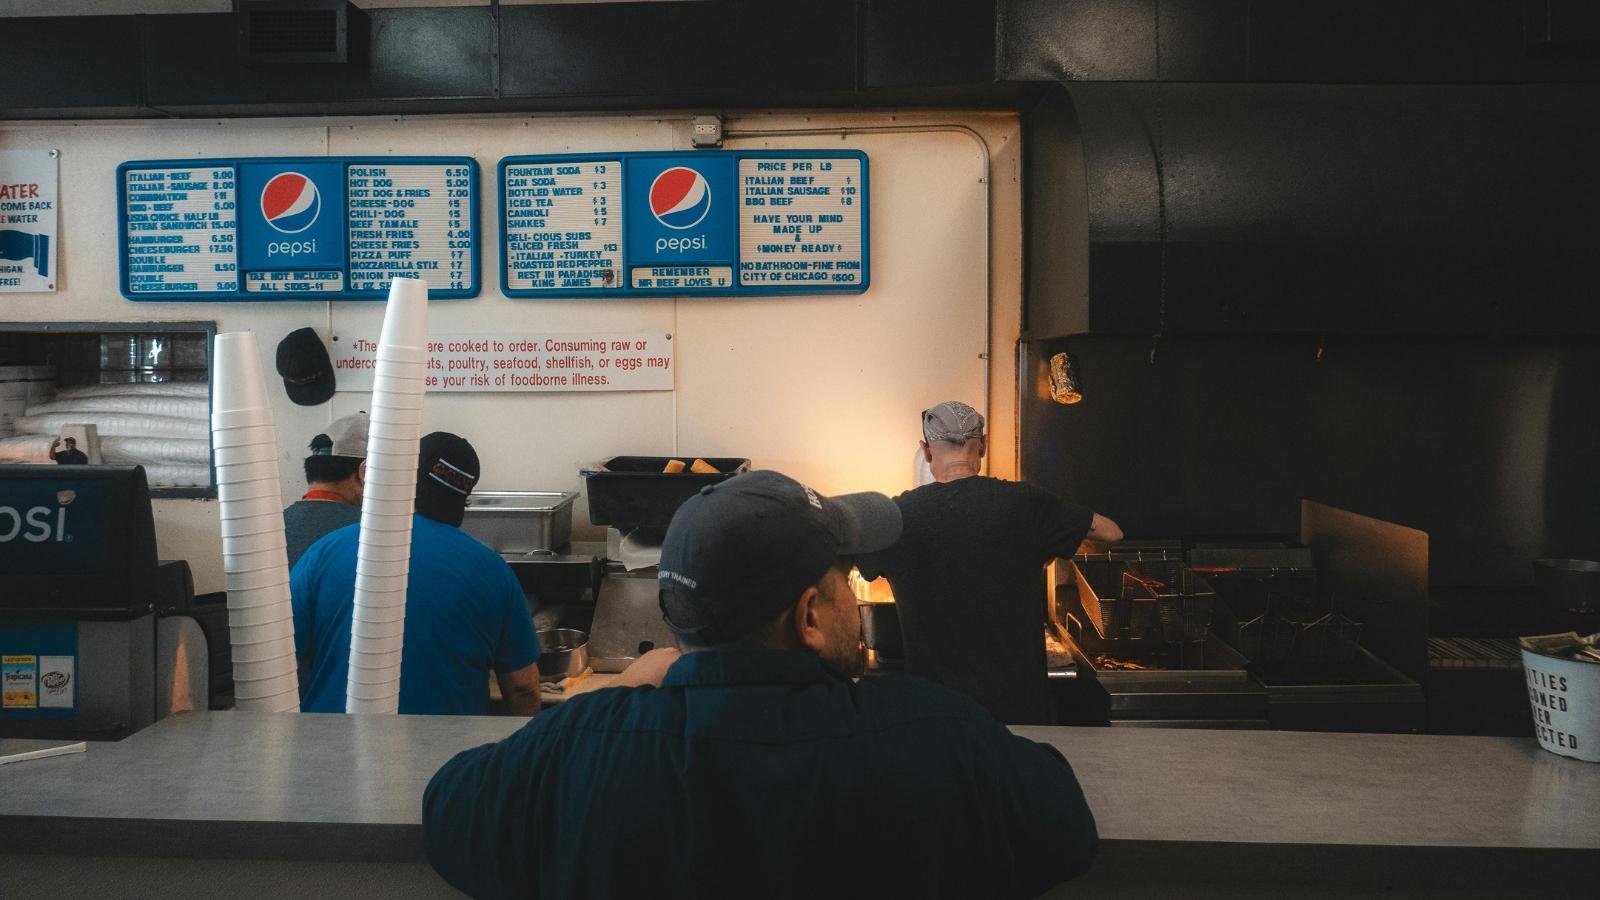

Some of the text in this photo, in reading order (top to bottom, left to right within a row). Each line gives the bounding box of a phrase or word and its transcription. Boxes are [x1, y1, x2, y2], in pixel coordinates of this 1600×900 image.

[758, 163, 832, 171] PRICE PER LB
[508, 168, 553, 176] FOUNTAIN
[350, 179, 368, 187] HOT
[373, 179, 393, 187] DOG
[745, 177, 815, 185] ITALIAN BEEF
[350, 189, 468, 197] HOT DOG & FRIES 7.00
[508, 189, 549, 197] BOTTLED
[745, 187, 783, 195] ITALIAN
[788, 187, 830, 195] SAUSAGE
[1, 201, 52, 211] COME BACK
[509, 199, 531, 207] ICED
[536, 199, 553, 207] TEA
[745, 198, 765, 206] BBQ
[770, 198, 793, 206] BEEF
[508, 209, 549, 217] CANNOLI
[8, 215, 38, 223] WATER
[753, 215, 843, 223] HAVE YOUR MIND
[351, 220, 373, 228] BEEF
[379, 220, 418, 228] TAMALE
[508, 220, 545, 228] SHAKES
[447, 230, 470, 238] 4.00
[565, 232, 591, 240] SUBS
[795, 234, 801, 242] &
[268, 239, 315, 257] pepsi
[351, 241, 388, 249] CHEESE
[392, 241, 420, 249] FRIES
[511, 242, 543, 250] SLICED
[548, 241, 579, 249] FRESH
[656, 235, 705, 253] pepsi
[351, 251, 382, 259] PIZZA
[388, 251, 412, 259] PUFF
[417, 261, 438, 269] STIX
[557, 260, 576, 268] RED
[577, 259, 613, 267] PEPPER
[741, 262, 754, 270] NO
[270, 272, 289, 280] NOT
[293, 272, 338, 280] INCLUDED
[352, 272, 383, 280] ONION
[518, 271, 539, 279] REST
[559, 270, 604, 278] PARADISE
[652, 268, 710, 276] REMEMBER
[785, 272, 828, 280] CHICAGO
[832, 274, 854, 282] $500
[532, 278, 591, 287] KING JAMES
[639, 279, 652, 287] MR
[685, 278, 712, 286] LOVES
[427, 339, 647, 353] are cooked to order. Consuming raw or
[448, 357, 670, 371] poultry, seafood, shellfish, or eggs may
[443, 373, 610, 388] your risk of foodborne illness.
